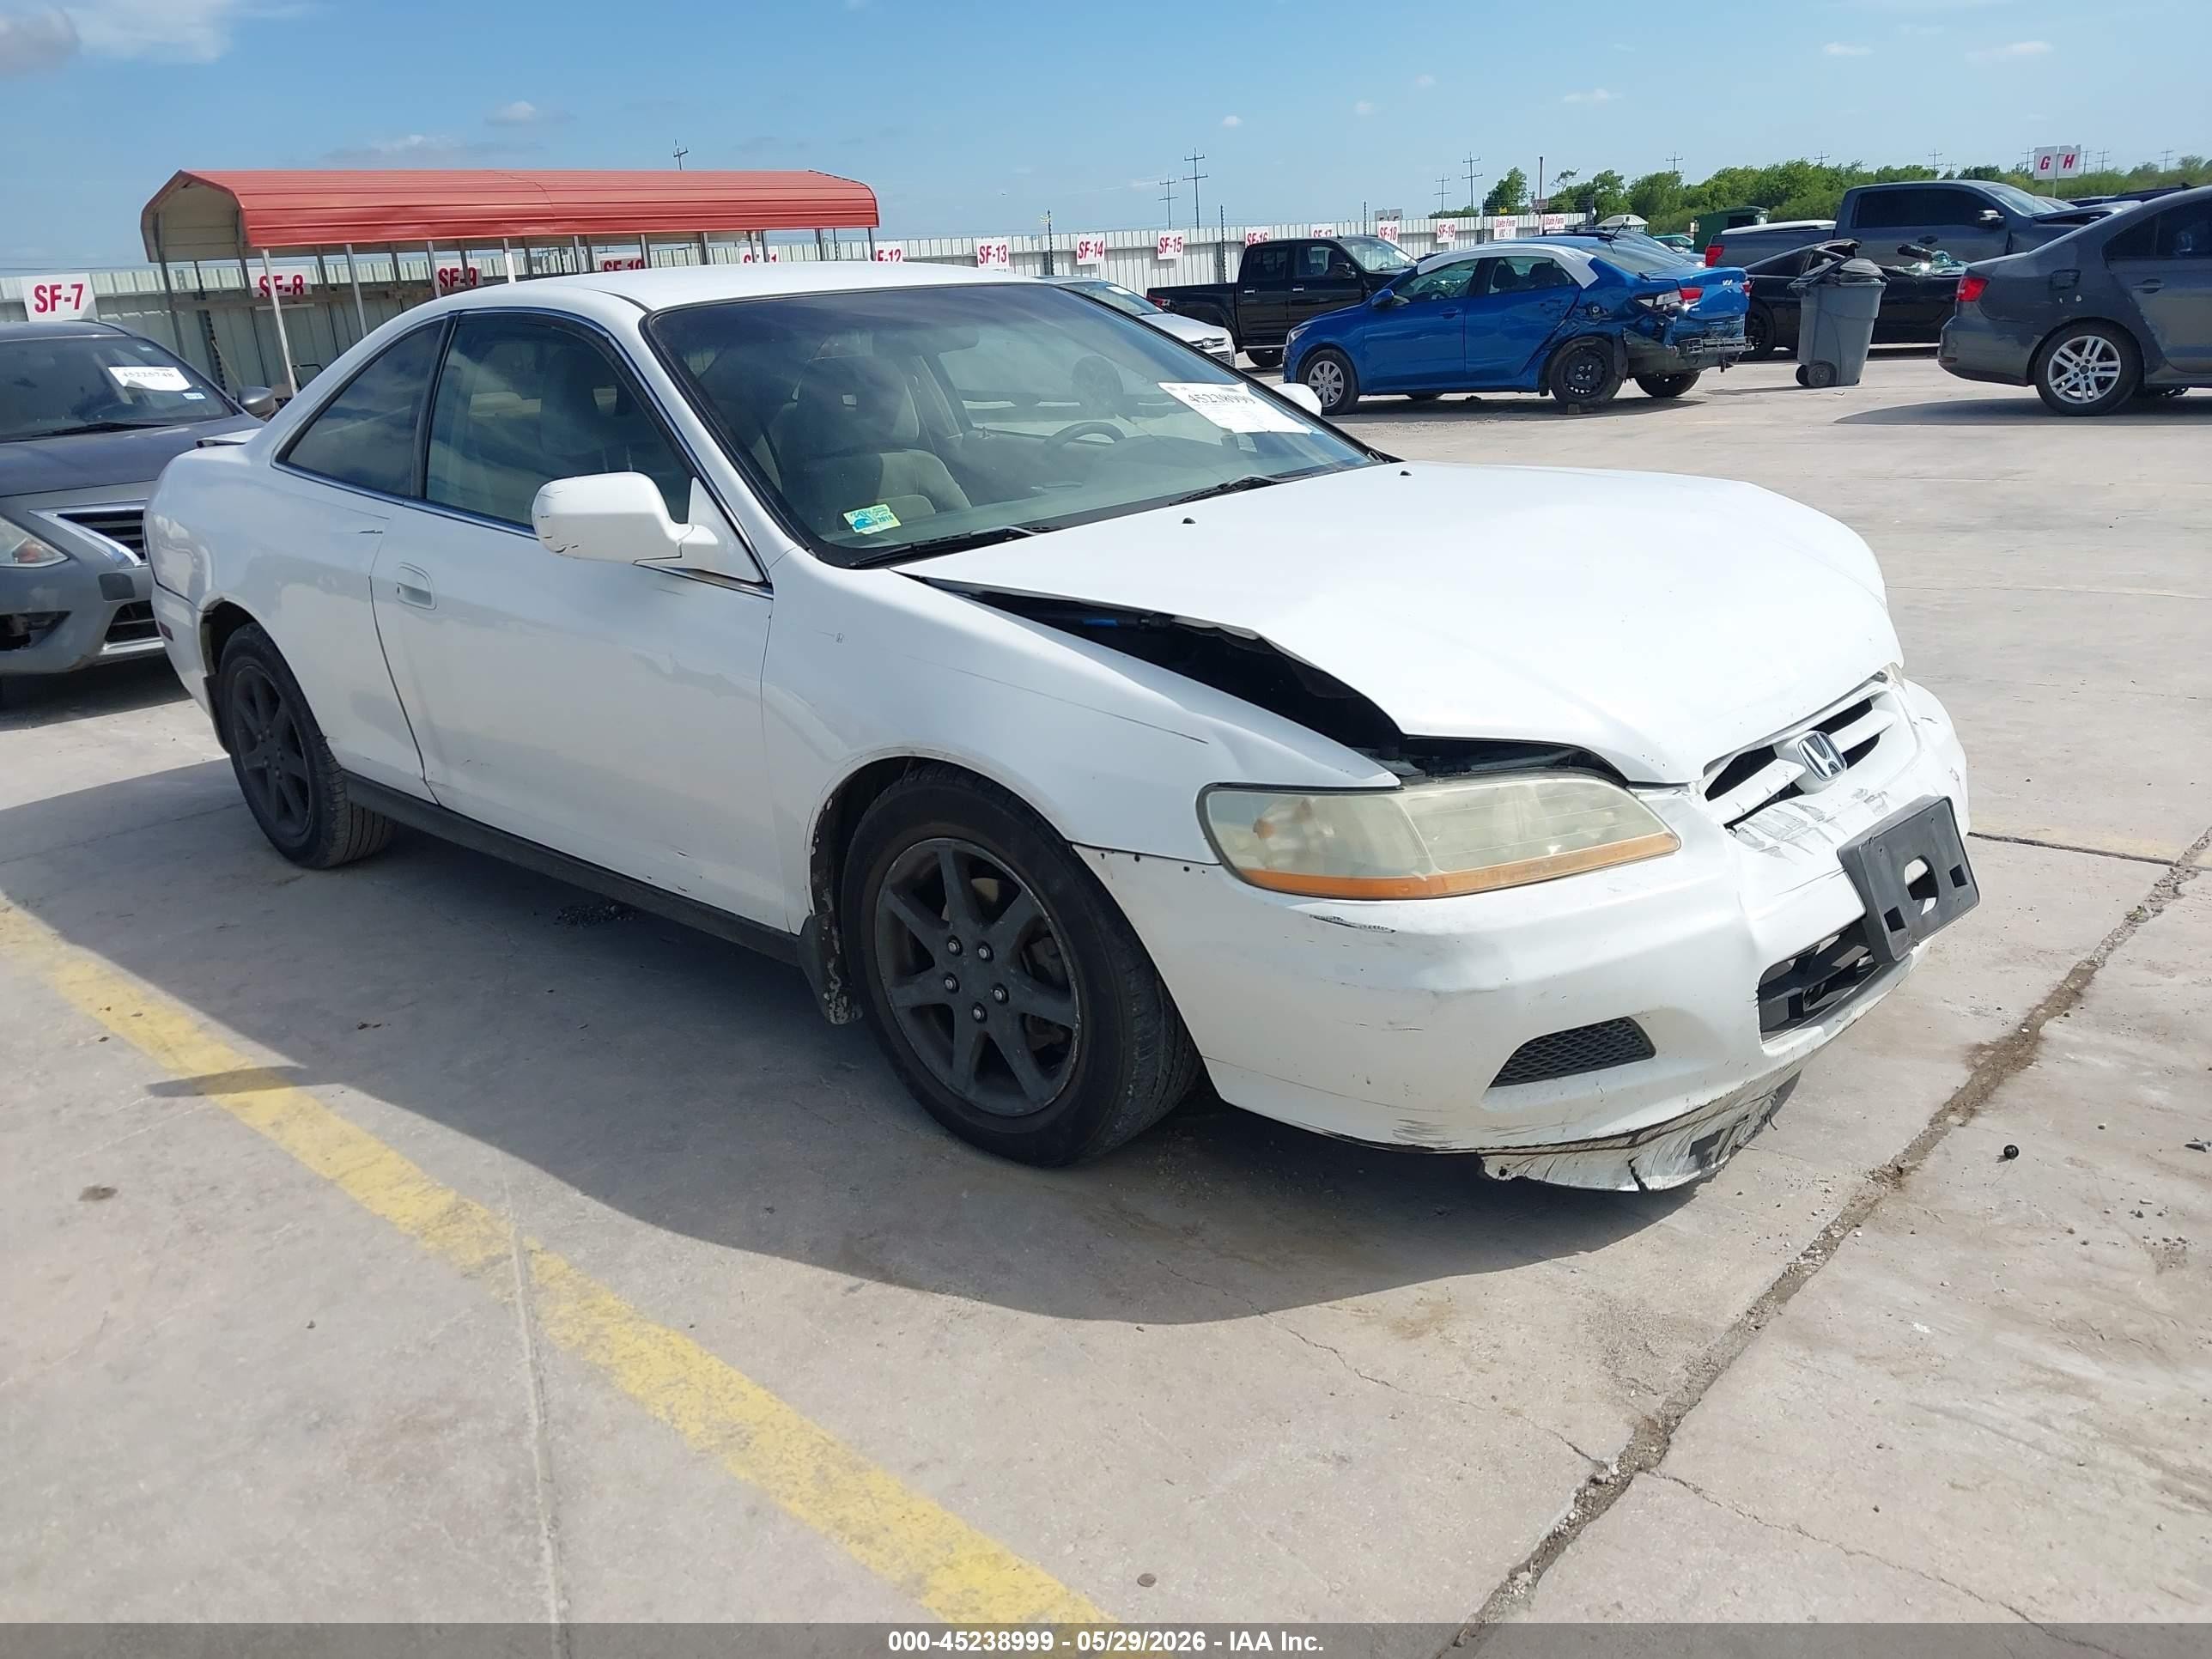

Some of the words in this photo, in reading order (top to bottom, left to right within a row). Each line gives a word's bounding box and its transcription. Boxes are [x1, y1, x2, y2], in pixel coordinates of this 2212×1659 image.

[2040, 155, 2051, 170] G
[2063, 155, 2075, 168] H
[1379, 226, 1398, 240] SF-18
[1437, 223, 1455, 239] SF-19
[1078, 240, 1103, 259] SF-14
[1158, 236, 1182, 254] SF-15
[979, 244, 1007, 264] SF-13
[34, 283, 83, 313] SF-7
